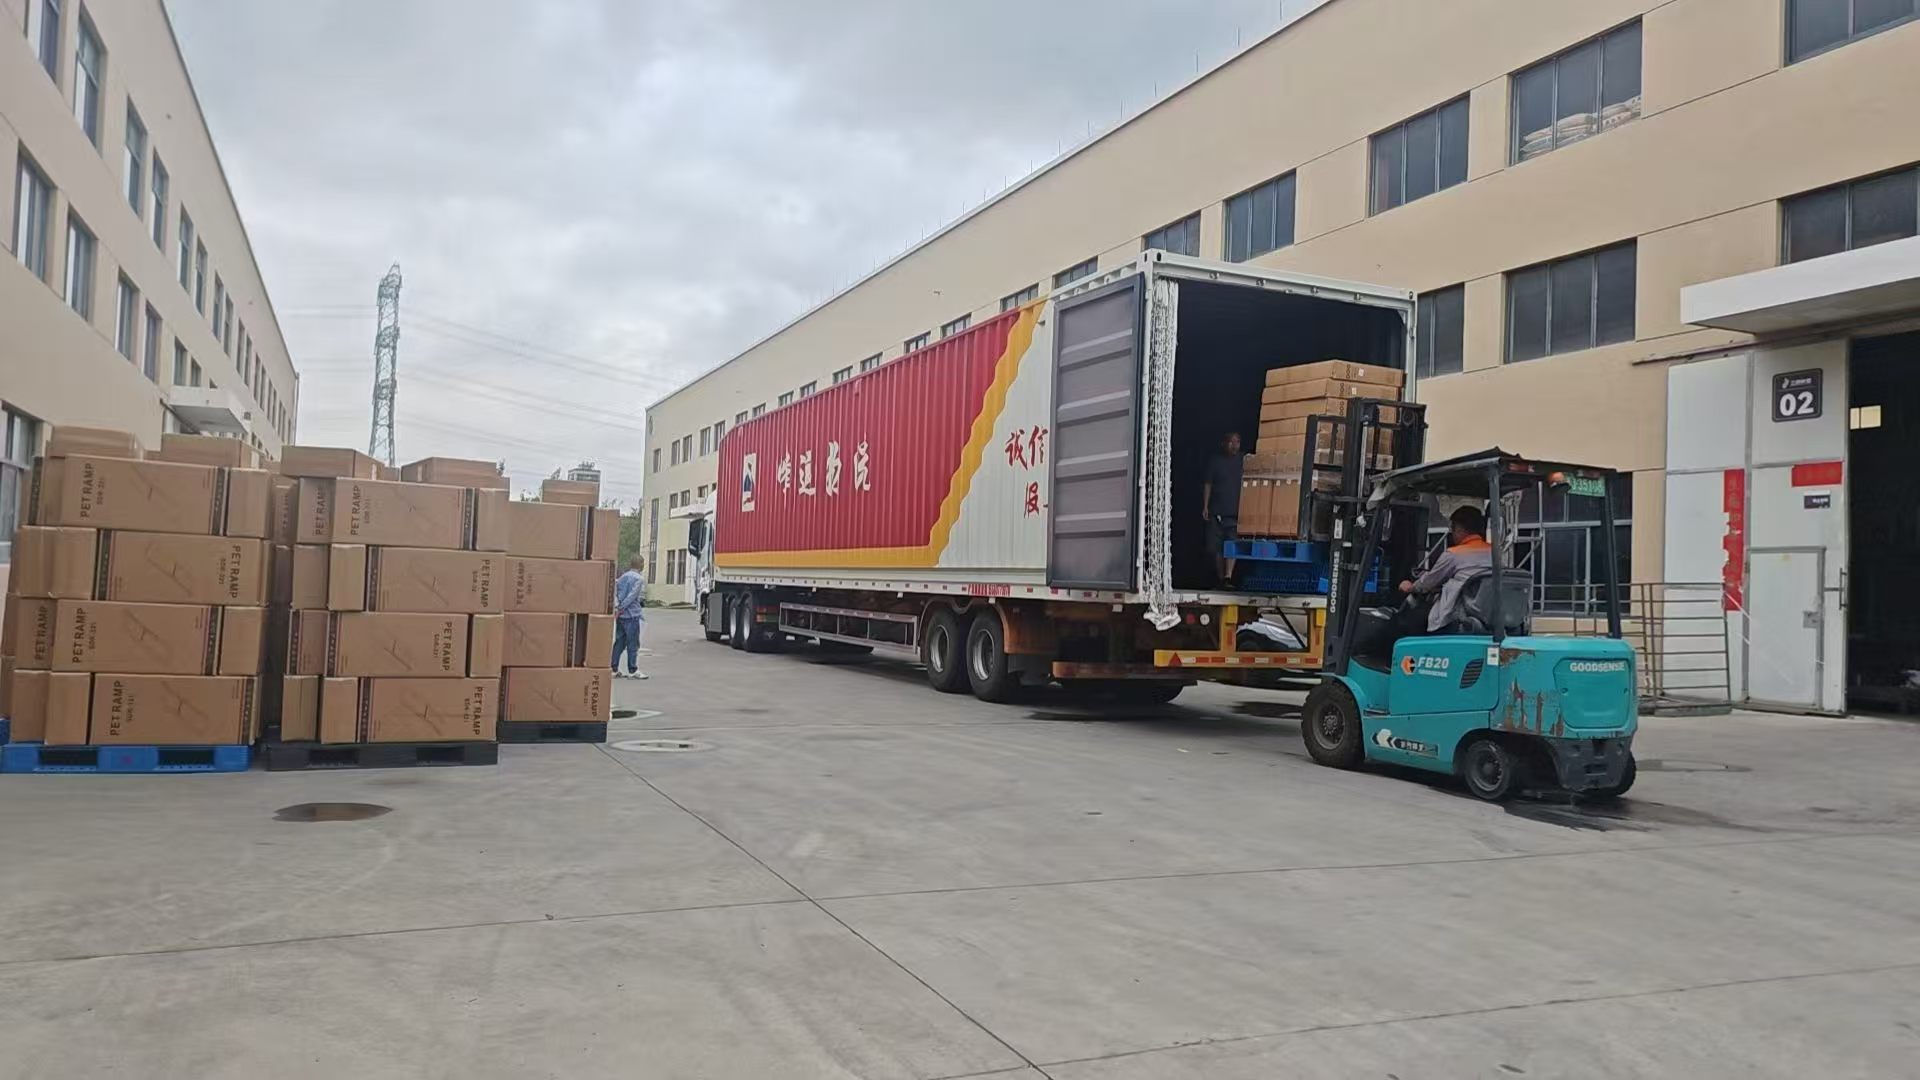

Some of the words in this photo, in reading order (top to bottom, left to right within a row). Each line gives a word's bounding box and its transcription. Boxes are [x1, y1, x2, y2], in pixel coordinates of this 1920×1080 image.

[1780, 391, 1814, 416] 02
[350, 516, 360, 535] PET
[231, 545, 241, 567] PET
[481, 560, 490, 577] PET
[1330, 551, 1340, 613] GOODSENSE
[443, 621, 452, 641] PET
[72, 642, 83, 663] PET
[1418, 657, 1449, 669] FB20
[1570, 661, 1625, 672] GOODSENSE
[474, 686, 483, 705] PET
[110, 714, 121, 736] PET
